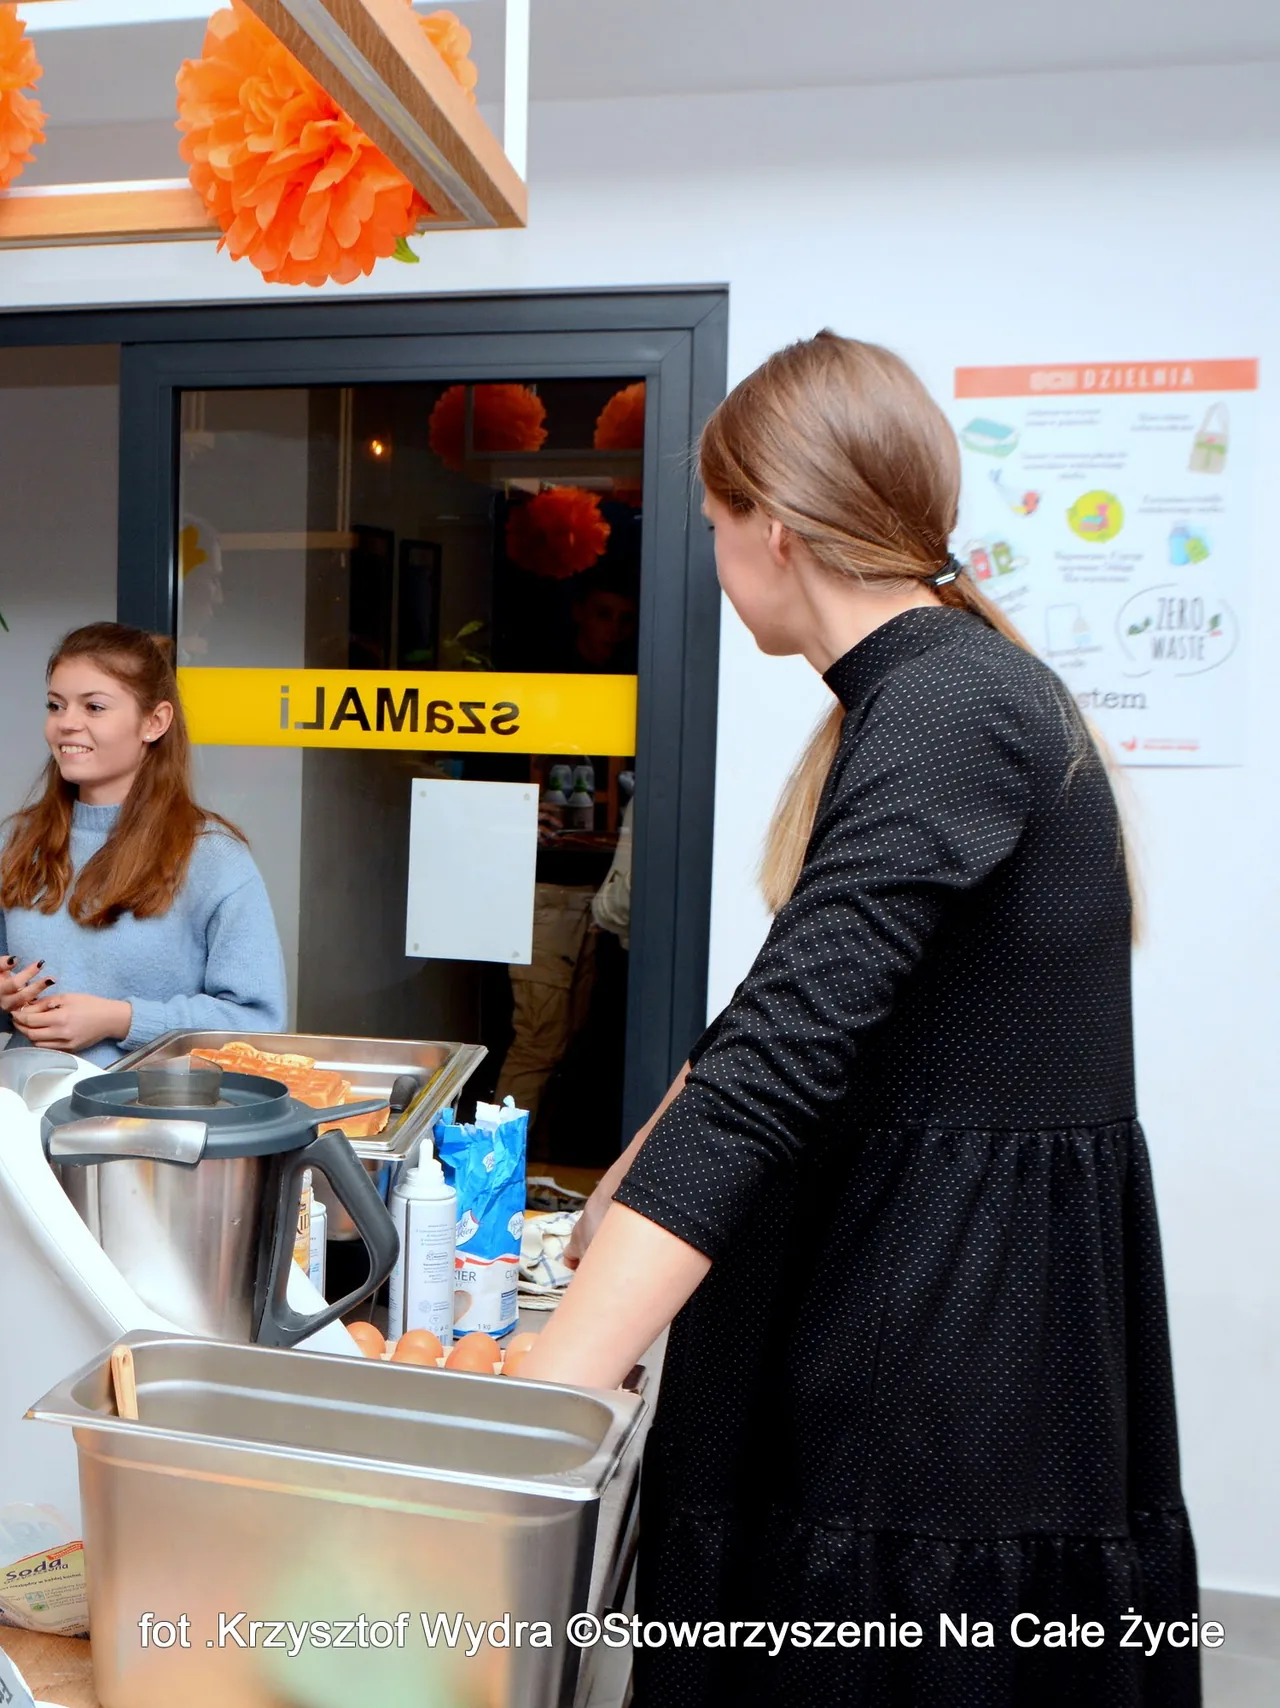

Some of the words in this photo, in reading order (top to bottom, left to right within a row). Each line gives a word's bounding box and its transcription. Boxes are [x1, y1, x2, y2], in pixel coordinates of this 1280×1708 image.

[1082, 368, 1195, 389] DZIELNIA
[1155, 596, 1205, 631] ZERO
[1151, 636, 1205, 661] WASTE
[6, 1559, 61, 1580] Soda
